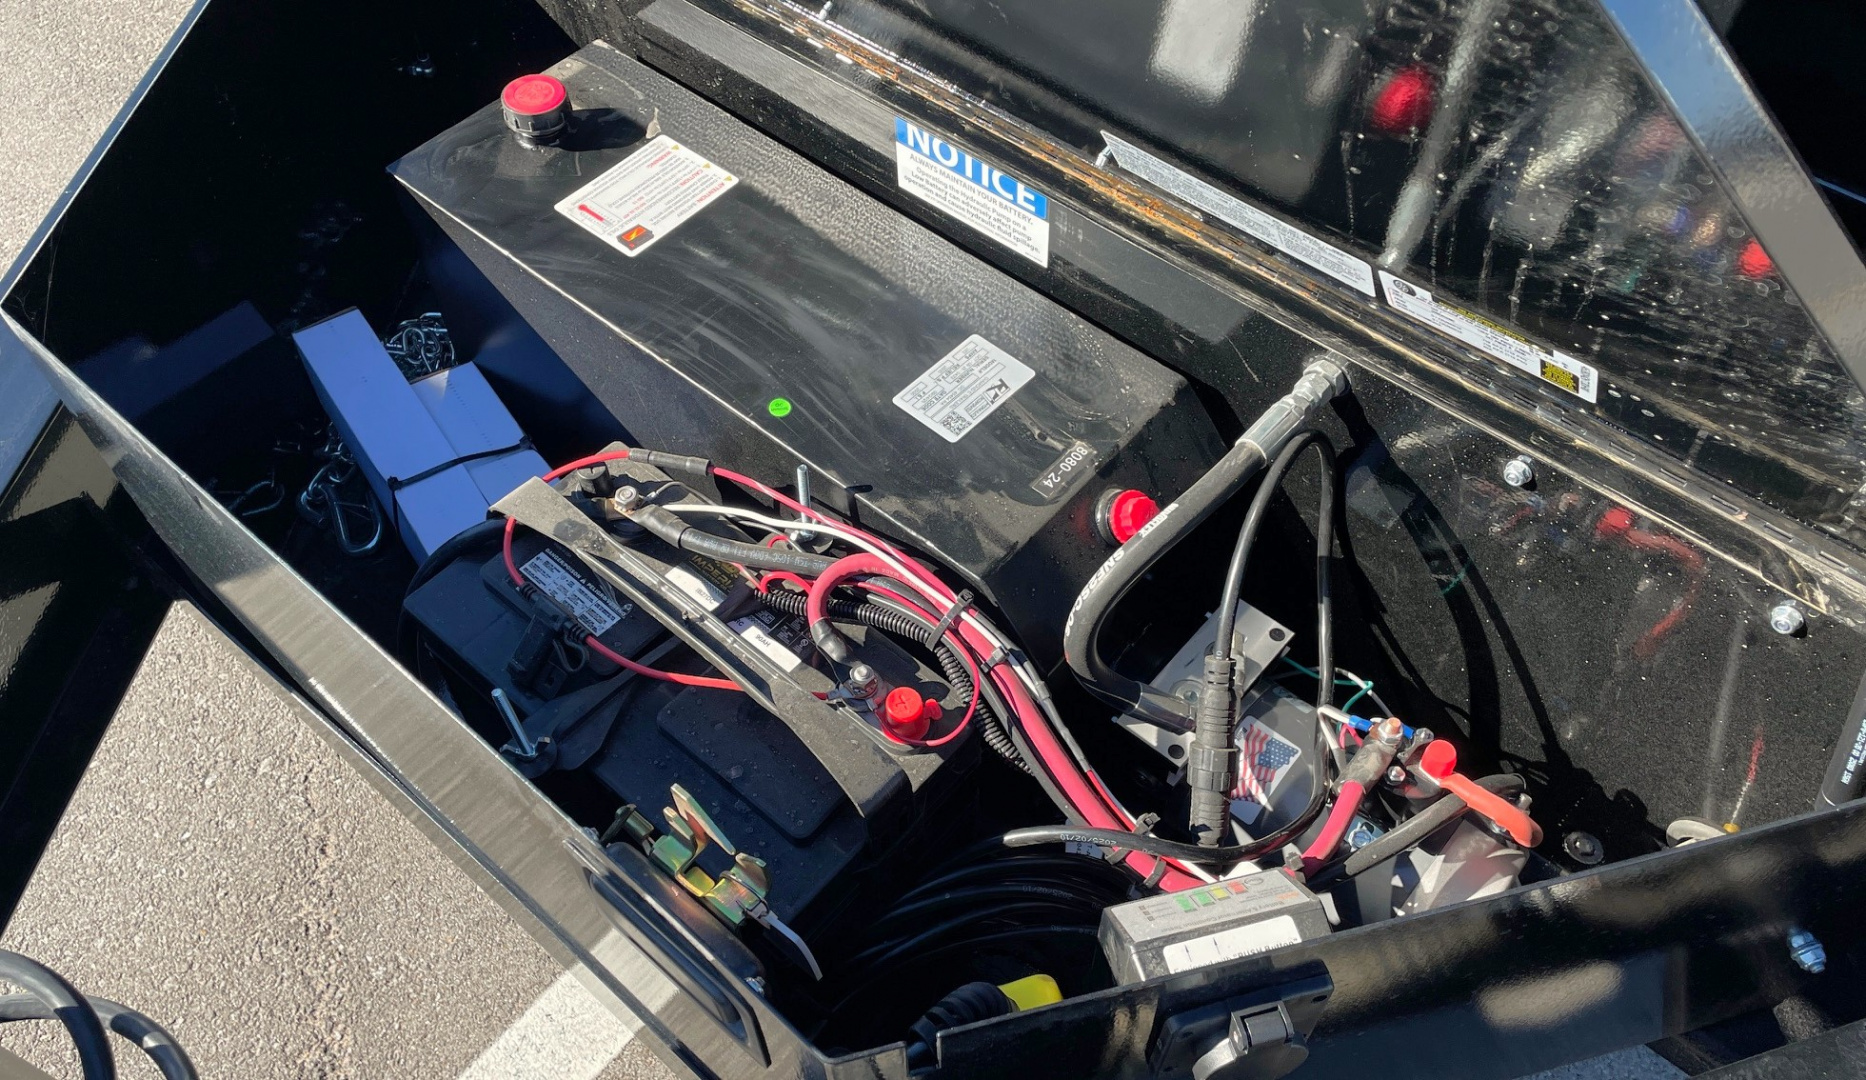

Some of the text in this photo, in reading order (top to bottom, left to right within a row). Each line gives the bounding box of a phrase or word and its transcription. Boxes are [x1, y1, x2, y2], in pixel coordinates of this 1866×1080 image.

[906, 123, 1035, 211] NOTICE
[909, 151, 937, 174] ALWAYS
[938, 167, 975, 195] MAINTAIN
[976, 188, 997, 207] YOUR
[916, 165, 947, 189] Operating
[948, 183, 959, 196] the
[960, 190, 990, 213] Hydraulic
[991, 207, 1011, 225] Pump
[1012, 218, 1021, 230] on
[903, 172, 933, 196] operation
[934, 190, 946, 203] and
[947, 197, 965, 214] cause
[966, 207, 995, 231] hydraulic
[996, 224, 1011, 240] fluid
[911, 169, 923, 183] Low
[924, 177, 947, 196] Battery
[948, 190, 960, 203] can
[961, 197, 991, 221] adversely
[992, 214, 1011, 232] affect
[1012, 225, 1031, 243] pump
[1043, 446, 1089, 489] 8080-24
[1060, 834, 1116, 846] 2025/02/10
